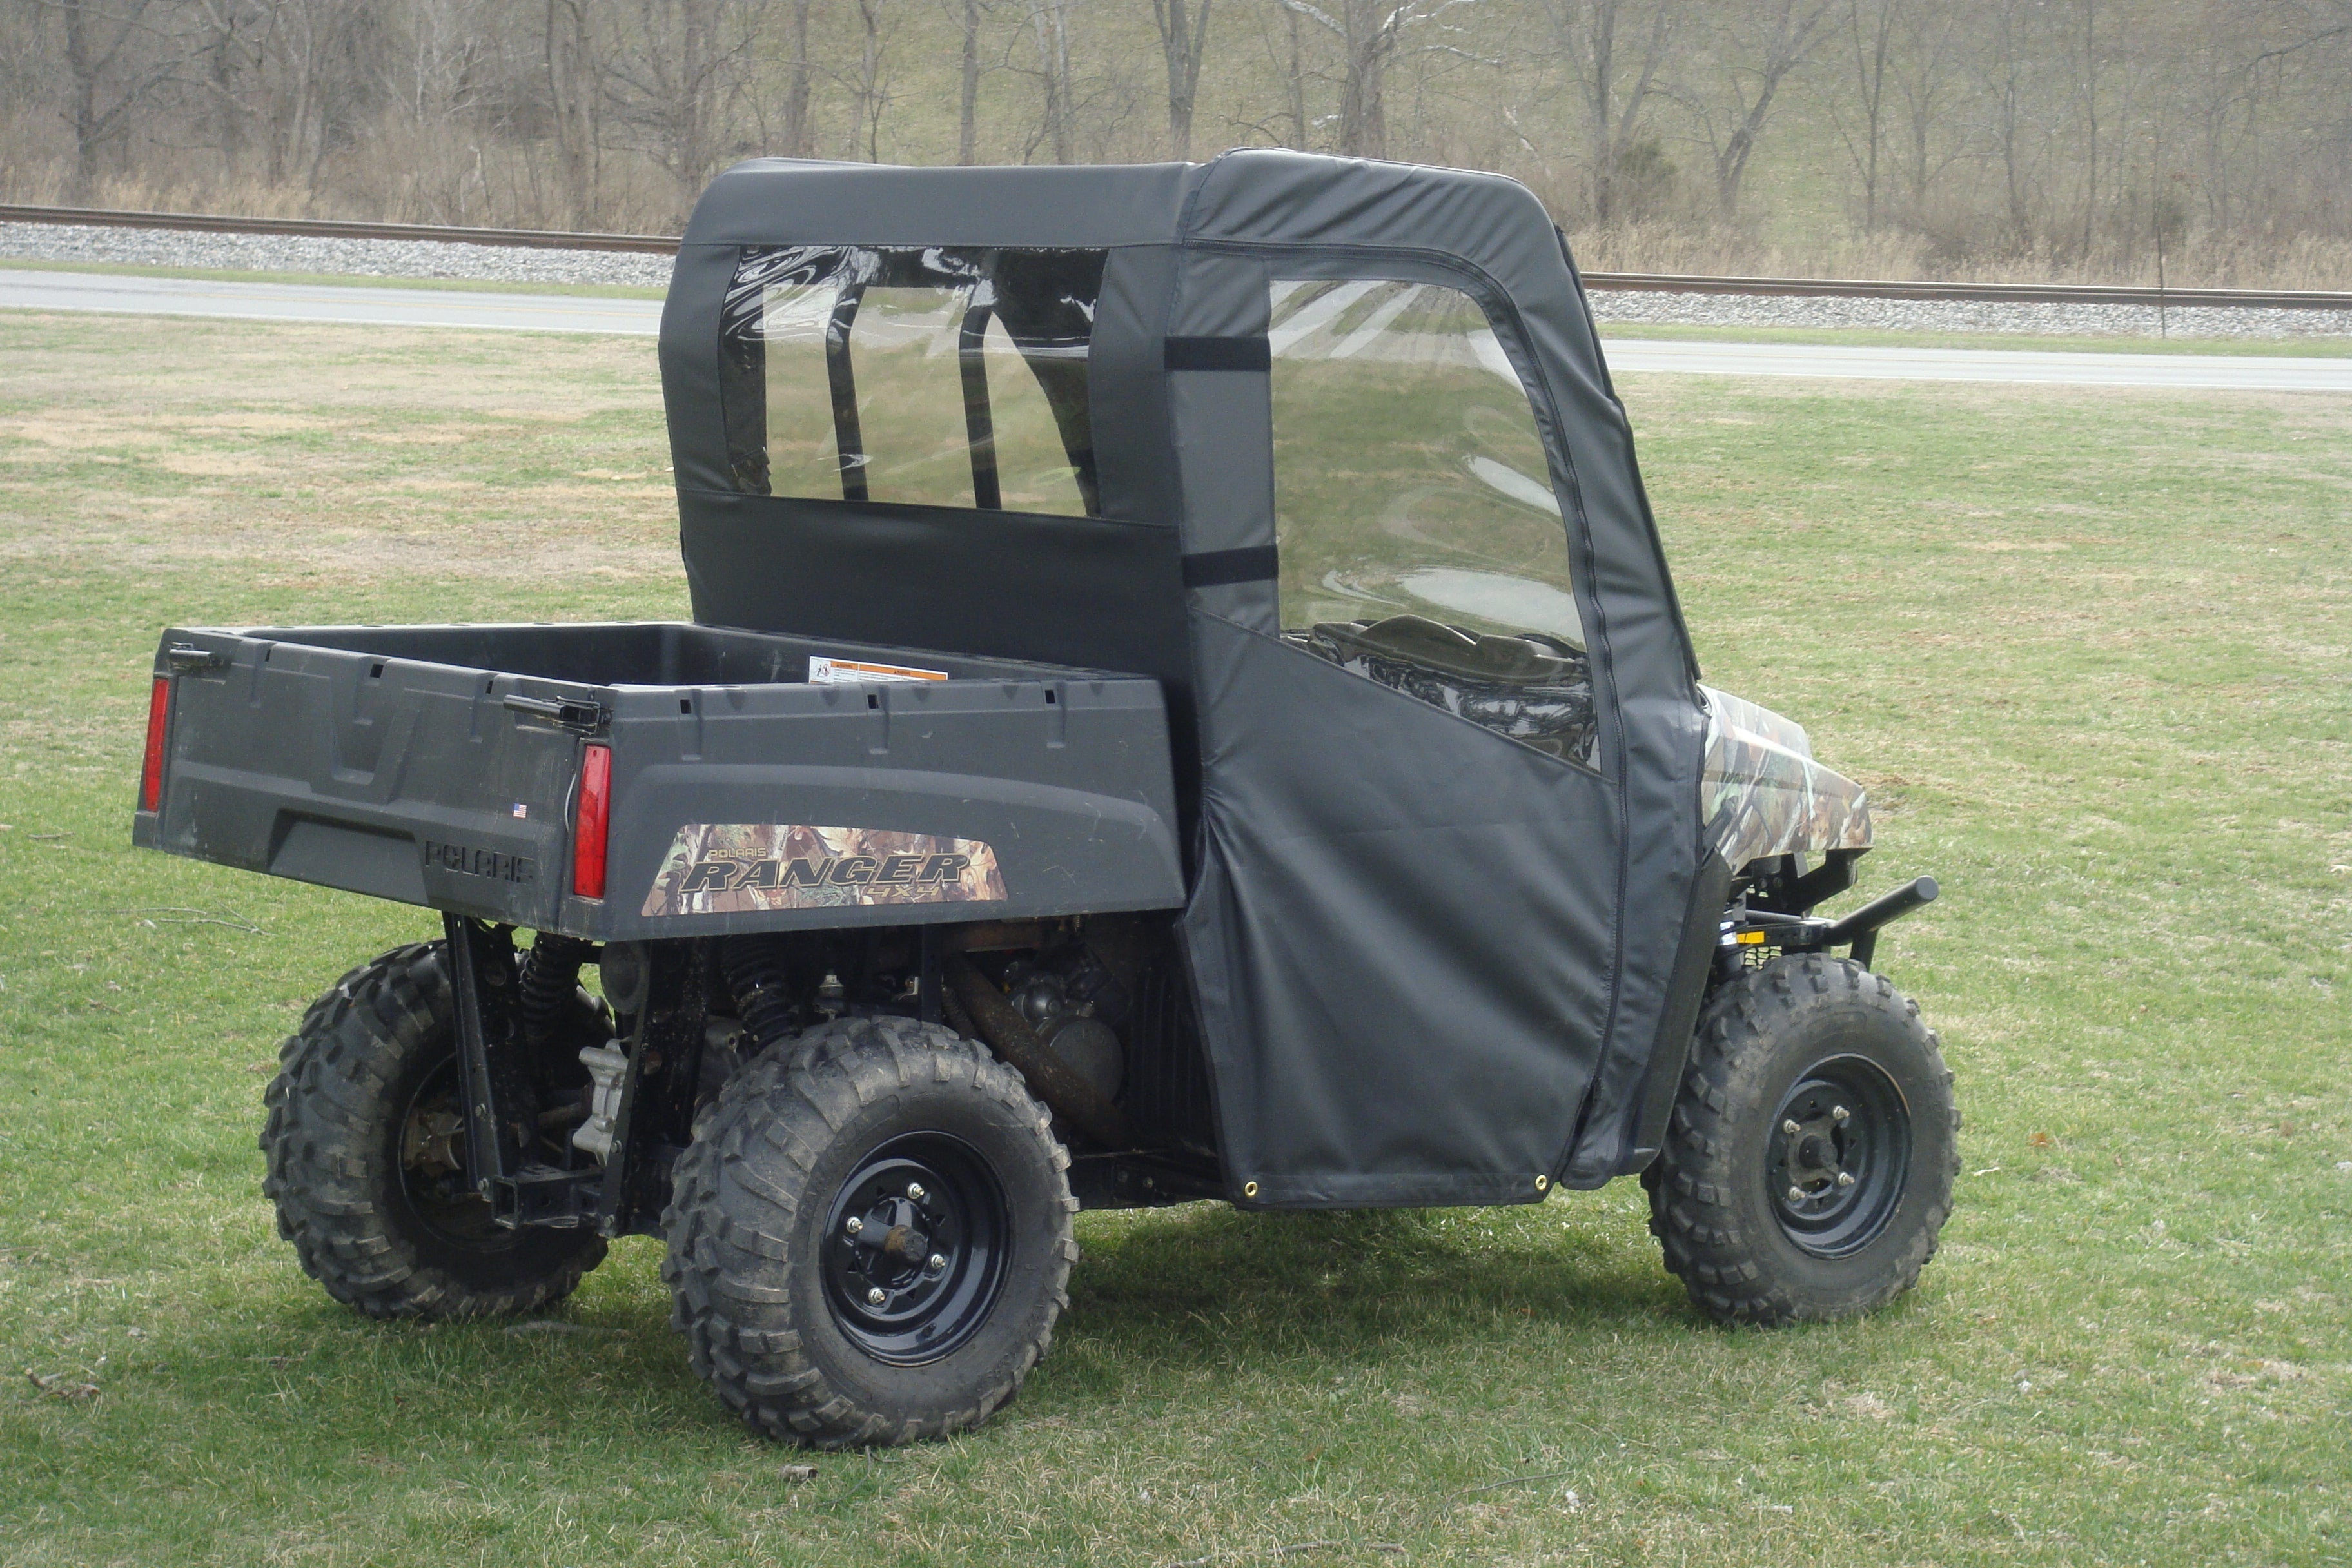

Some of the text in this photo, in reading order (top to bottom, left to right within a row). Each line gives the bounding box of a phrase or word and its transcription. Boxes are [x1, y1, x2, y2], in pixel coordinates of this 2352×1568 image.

[426, 840, 534, 884] POLARIS
[679, 853, 970, 893] RANGER
[709, 848, 767, 859] POLARIS
